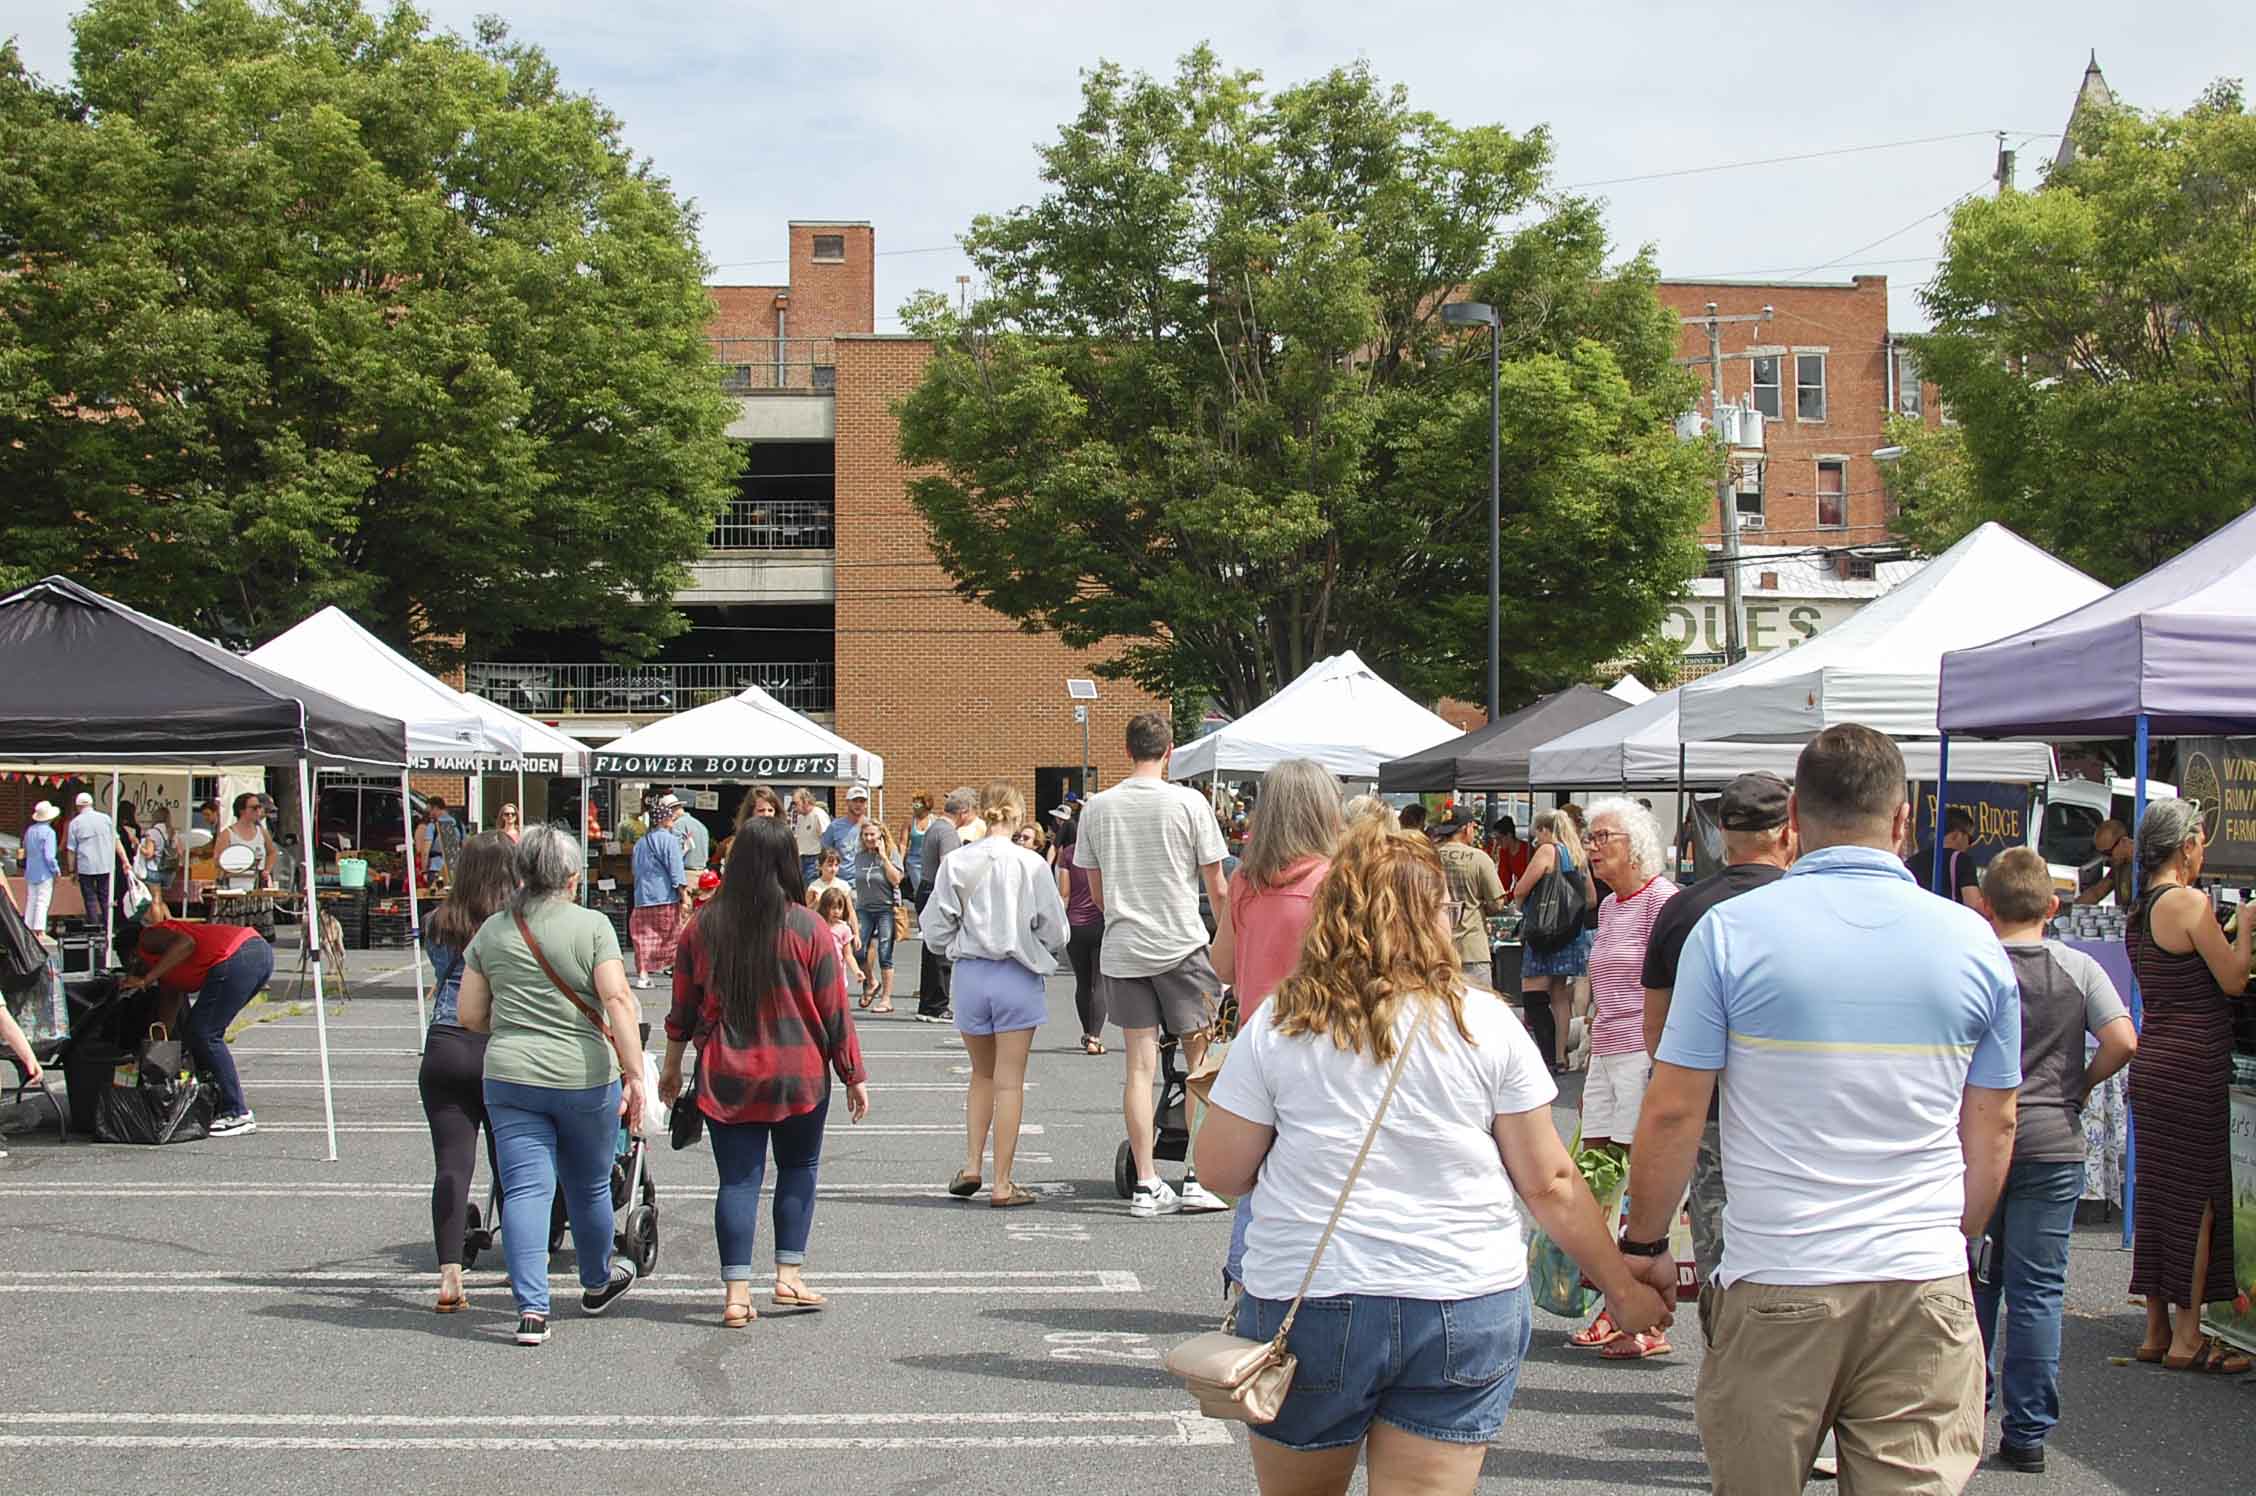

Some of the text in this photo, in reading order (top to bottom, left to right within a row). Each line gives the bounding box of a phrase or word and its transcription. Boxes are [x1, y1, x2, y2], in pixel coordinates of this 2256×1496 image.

[434, 756, 494, 771] MARKET
[500, 757, 559, 773] GARDEN
[594, 756, 836, 776] FLOWER BOUQUETS
